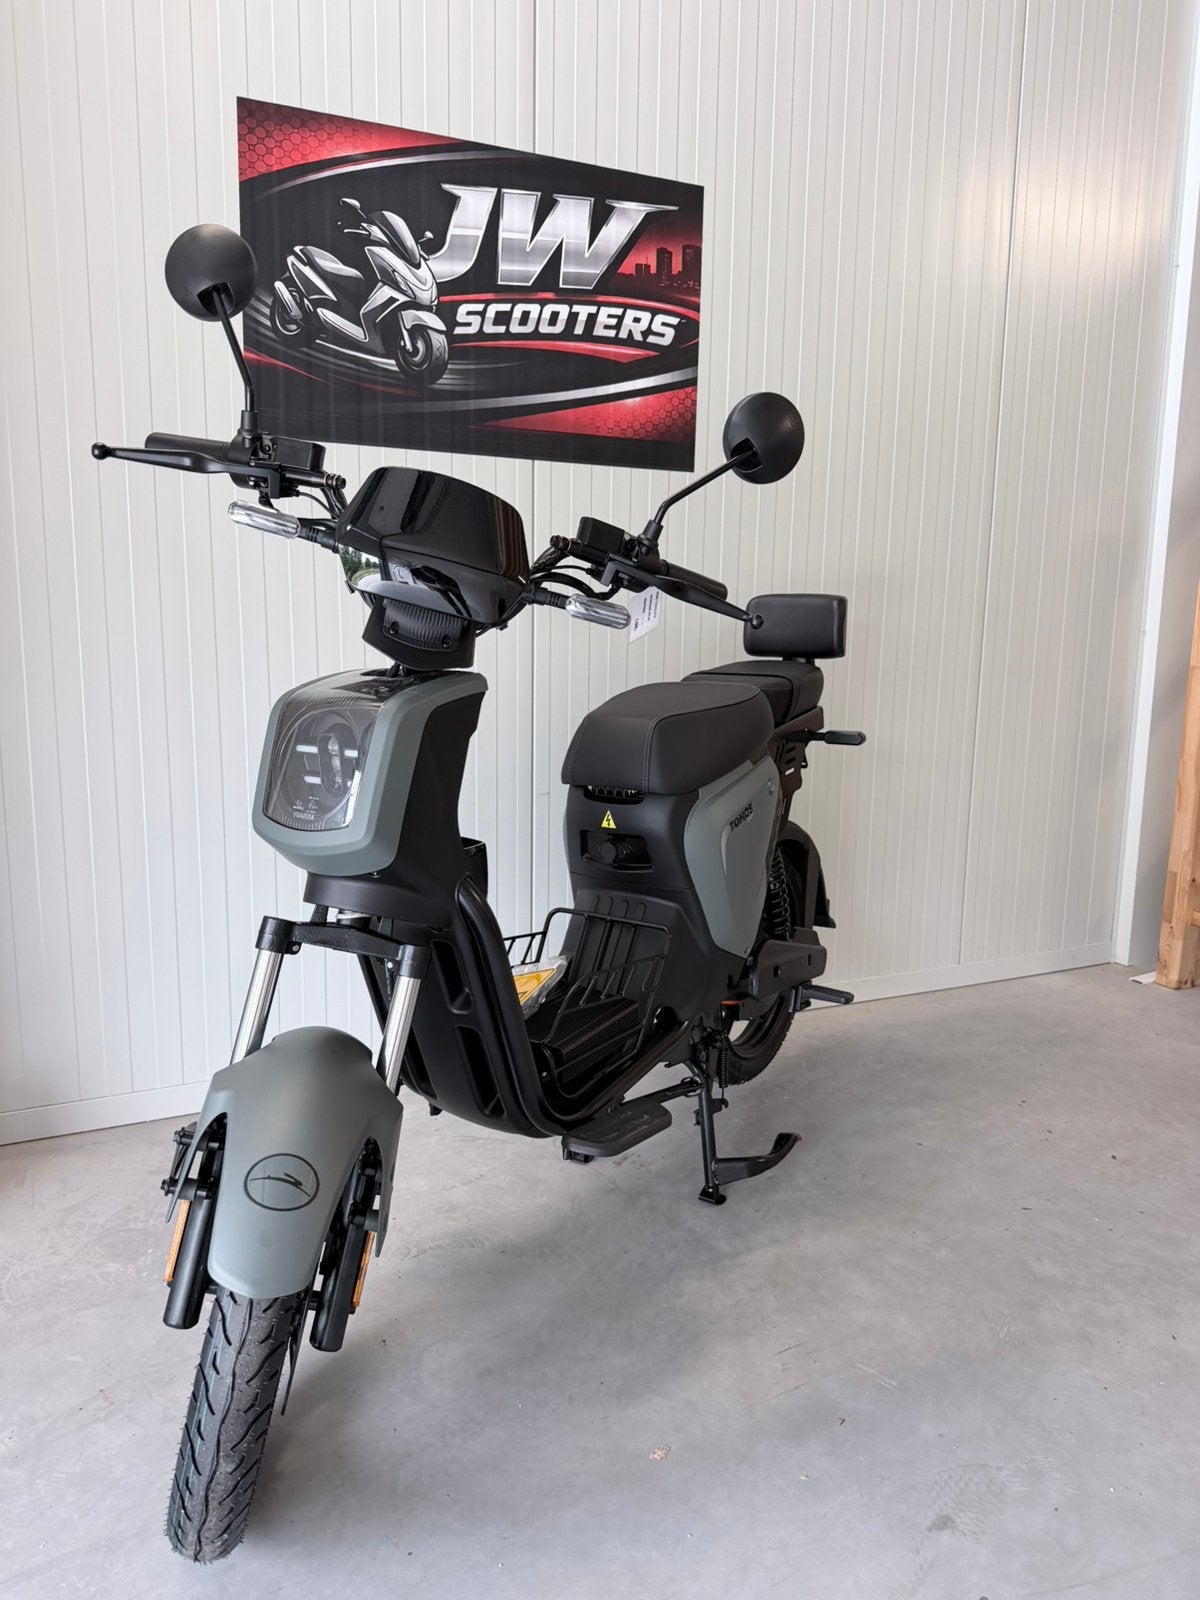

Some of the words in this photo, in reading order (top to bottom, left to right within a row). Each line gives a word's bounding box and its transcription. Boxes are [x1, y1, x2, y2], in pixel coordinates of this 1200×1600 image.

[428, 183, 679, 289] JW
[453, 303, 681, 346] SCOOTERS
[728, 802, 754, 832] TOMOS
